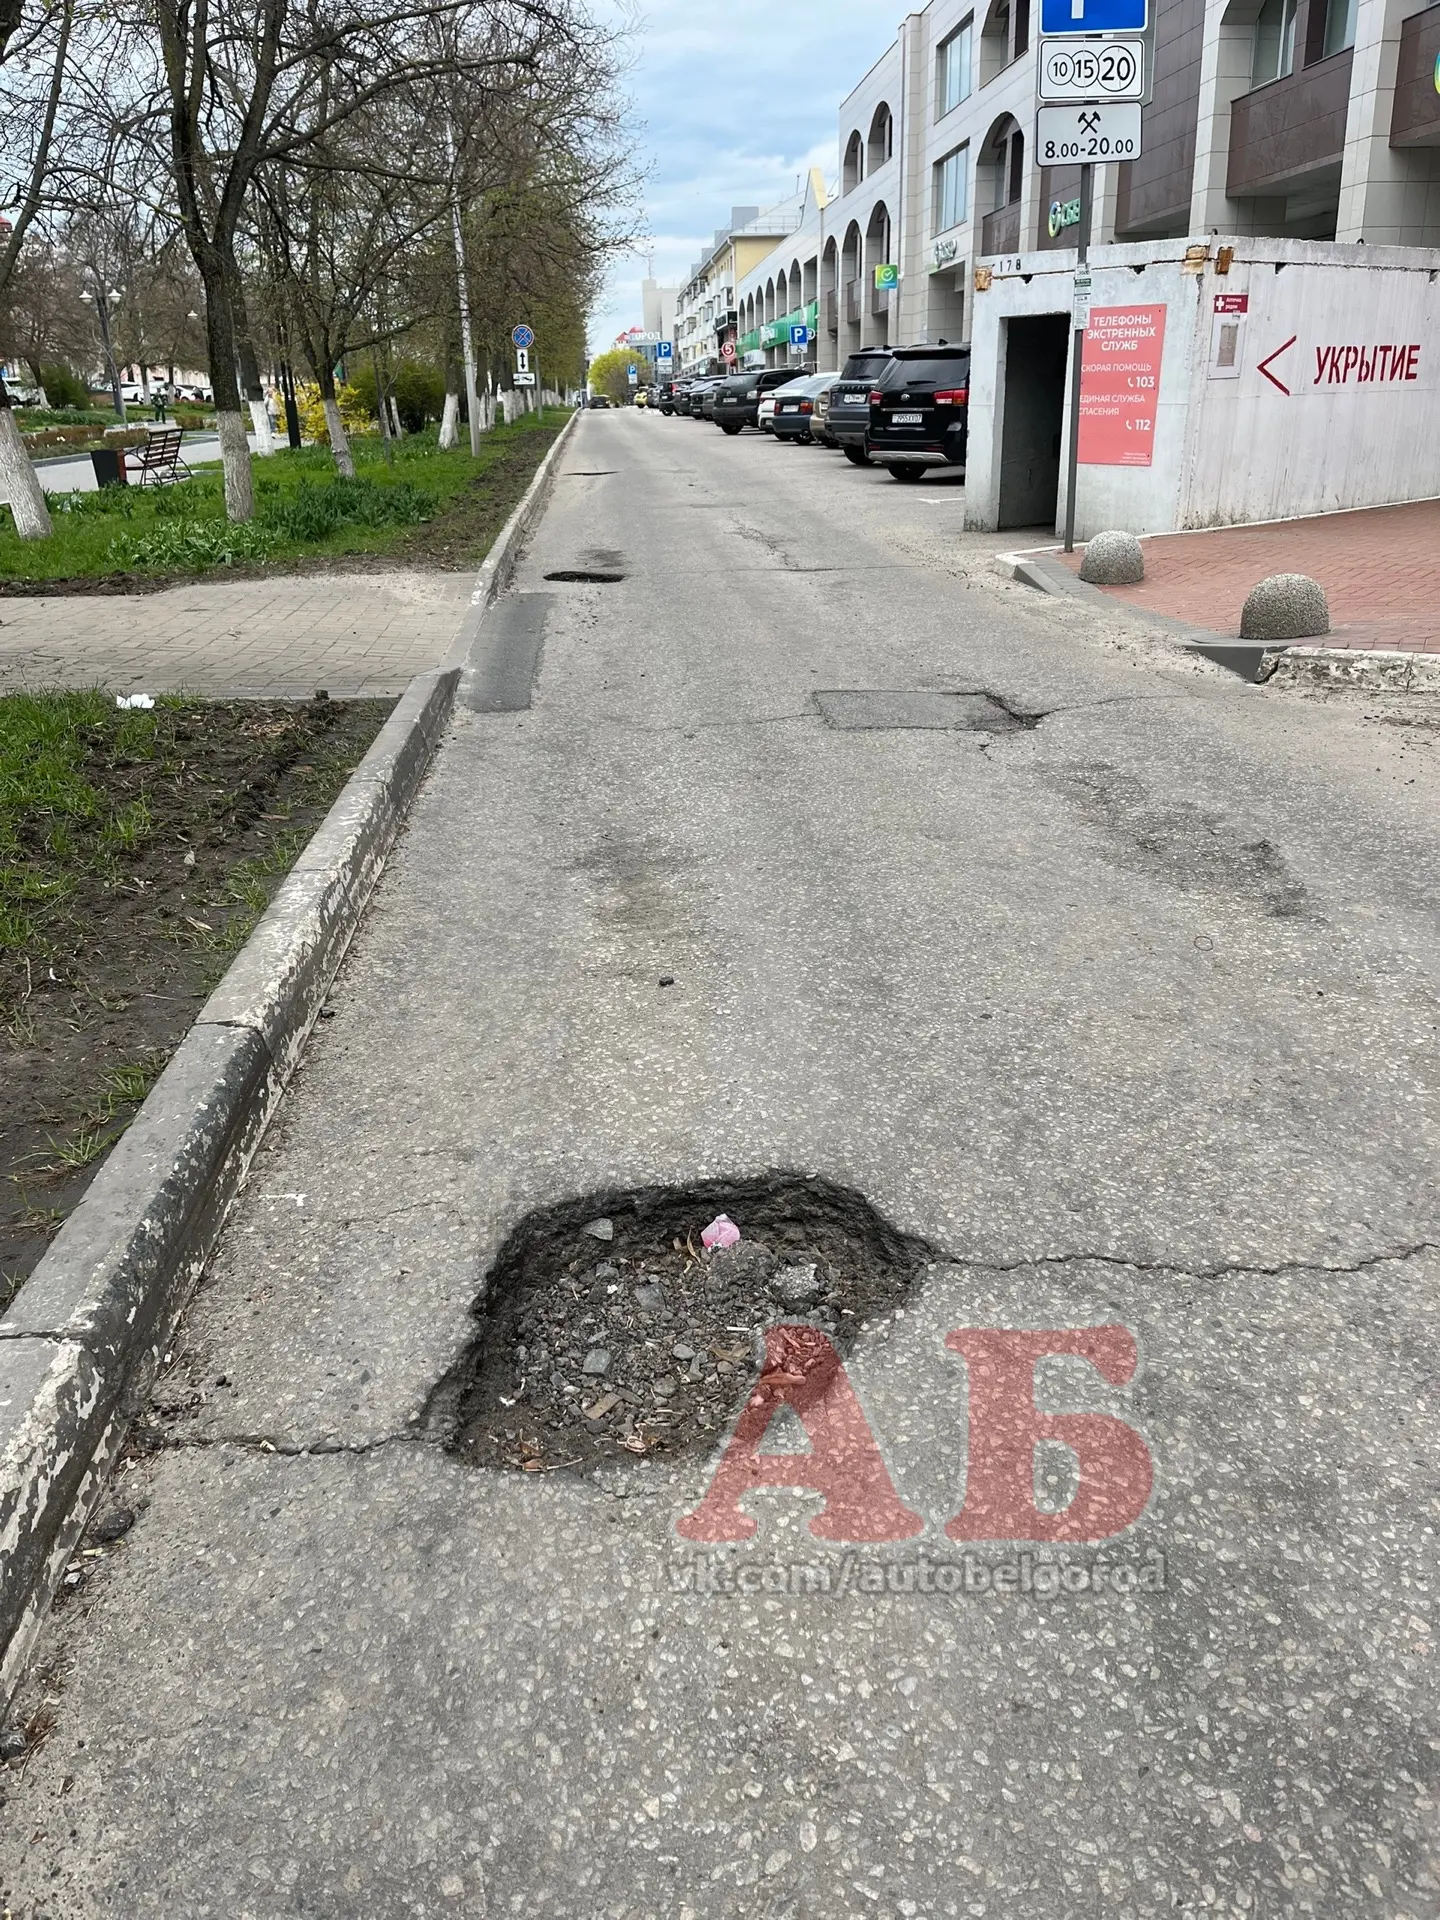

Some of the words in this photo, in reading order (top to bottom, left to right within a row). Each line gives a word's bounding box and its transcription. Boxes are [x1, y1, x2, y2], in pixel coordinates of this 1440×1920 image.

[1053, 62, 1068, 77] 10
[1075, 60, 1094, 78] 15
[1101, 57, 1131, 81] 20
[1045, 137, 1134, 159] 8.00-20.00
[1000, 259, 1021, 272] 178
[1093, 314, 1152, 327] ТЕЛЕФОНЫ
[794, 328, 803, 342] P
[1087, 327, 1156, 340] ЭКСТРЕННЫХ
[661, 343, 669, 356] P
[1101, 340, 1138, 351] СЛУЖБ
[1081, 363, 1111, 372] СКОРАЯ
[1112, 362, 1152, 372] ПОМОЩЬ
[1313, 345, 1421, 385] УКРЫТИЕ
[1136, 376, 1155, 388] 103
[1080, 395, 1110, 404] ЕДИНАЯ
[1111, 394, 1145, 403] СЛУЖБА
[1135, 419, 1151, 431] 112
